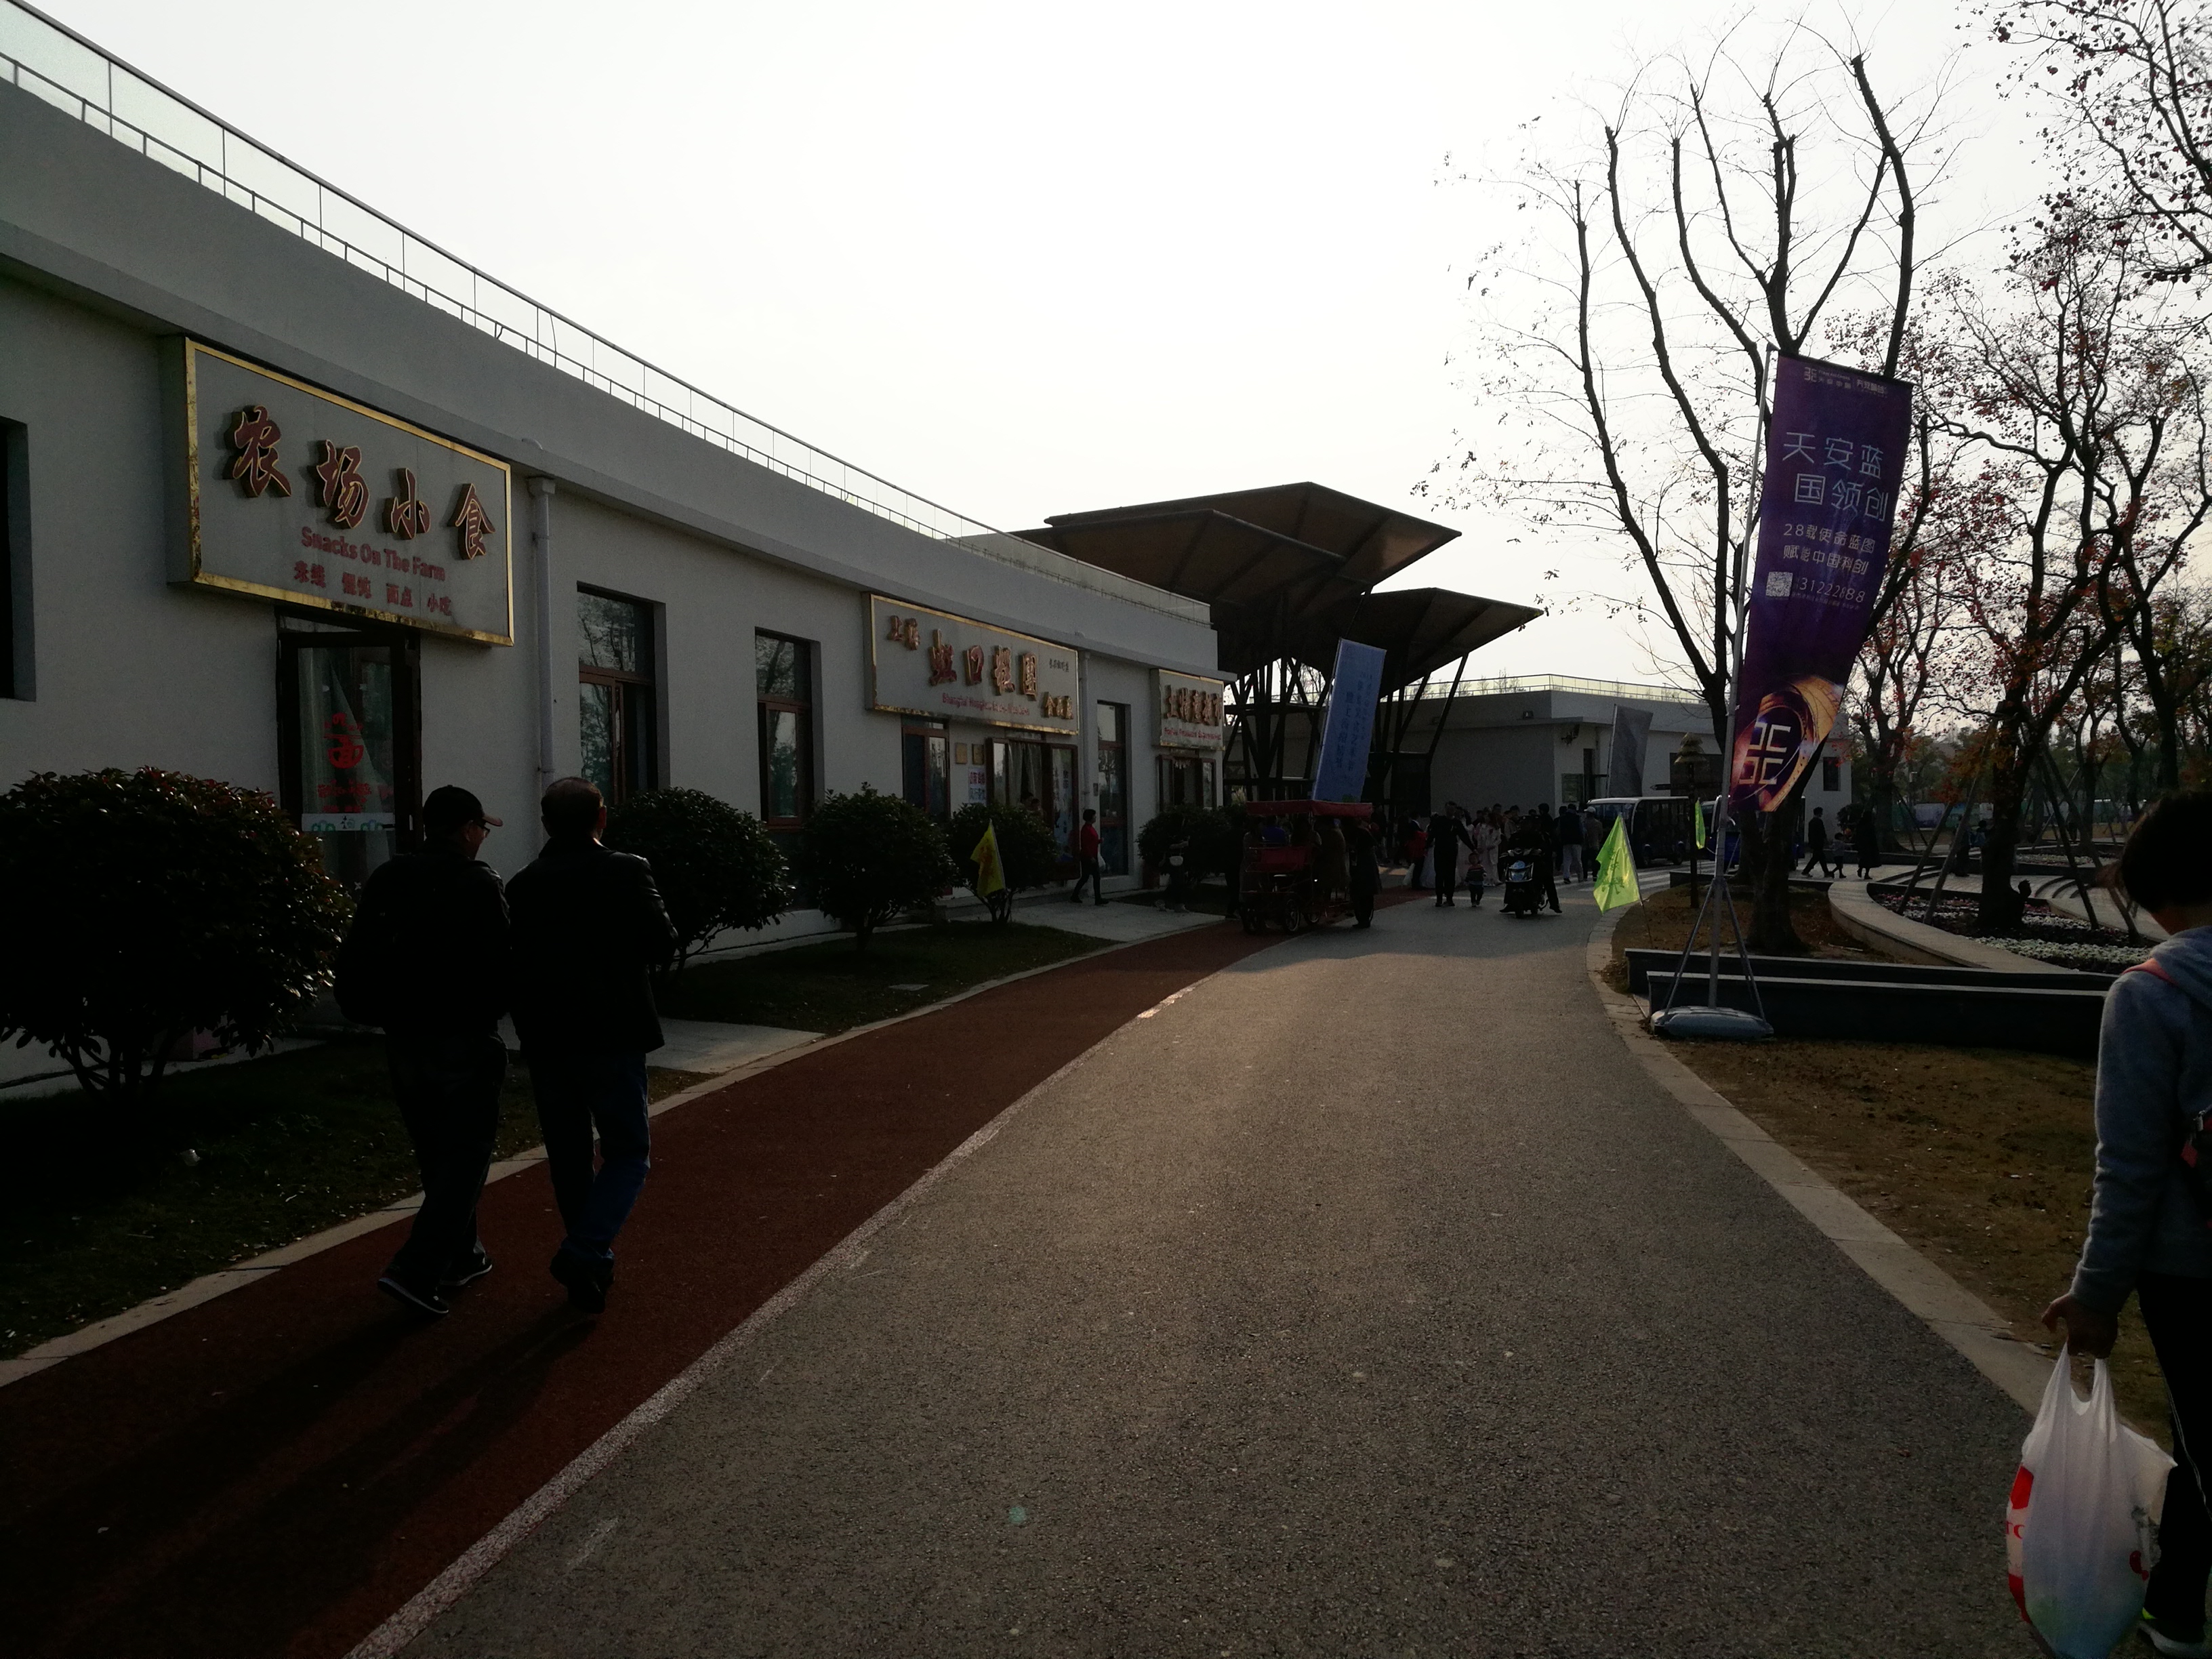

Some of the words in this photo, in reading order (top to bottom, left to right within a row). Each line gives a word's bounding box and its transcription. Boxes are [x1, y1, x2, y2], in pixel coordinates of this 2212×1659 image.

[1782, 431, 1884, 479] 天安蓝
[226, 405, 496, 560] 农场小食
[1795, 472, 1889, 522] 国领创
[302, 526, 358, 560] Snacks
[360, 543, 382, 566] On
[384, 548, 410, 573] The
[413, 556, 446, 581] Farm
[1783, 523, 1876, 554] 28载使命蓝图
[1783, 544, 1869, 575] 赋能中国科创
[386, 582, 413, 608] 面点
[427, 592, 452, 616] 小吃
[1799, 577, 1865, 603] 31222888
